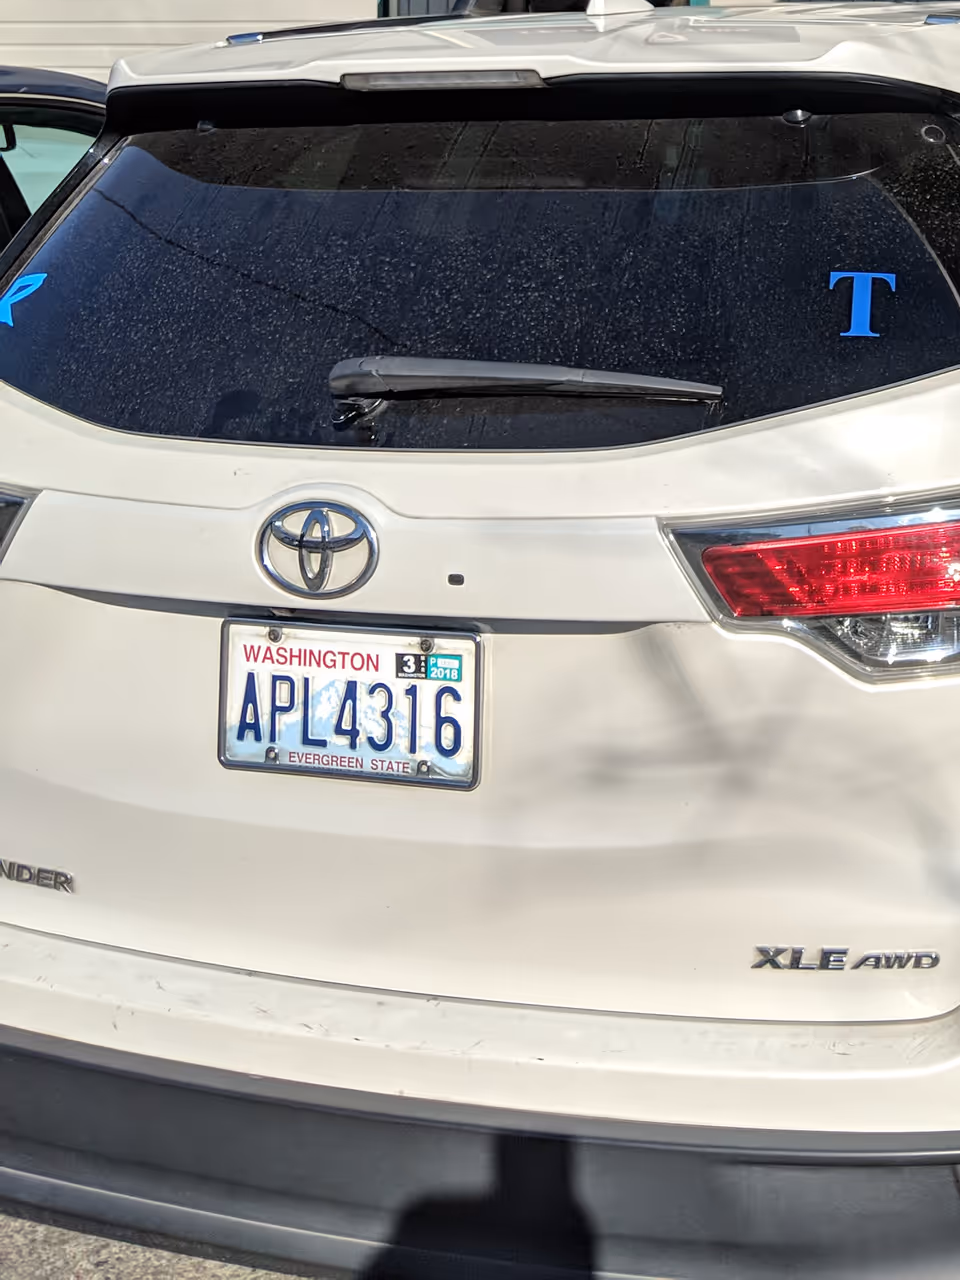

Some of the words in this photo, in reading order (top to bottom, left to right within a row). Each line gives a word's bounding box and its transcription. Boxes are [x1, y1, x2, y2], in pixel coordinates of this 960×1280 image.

[829, 271, 896, 337] T
[243, 643, 380, 673] WASHINGTON
[402, 655, 416, 673] 3
[430, 667, 459, 680] 2018
[236, 671, 462, 759] APL4316
[288, 751, 364, 770] EVERGREEN
[370, 757, 411, 774] STATE
[750, 944, 849, 971] XLE
[850, 950, 941, 970] AWD
